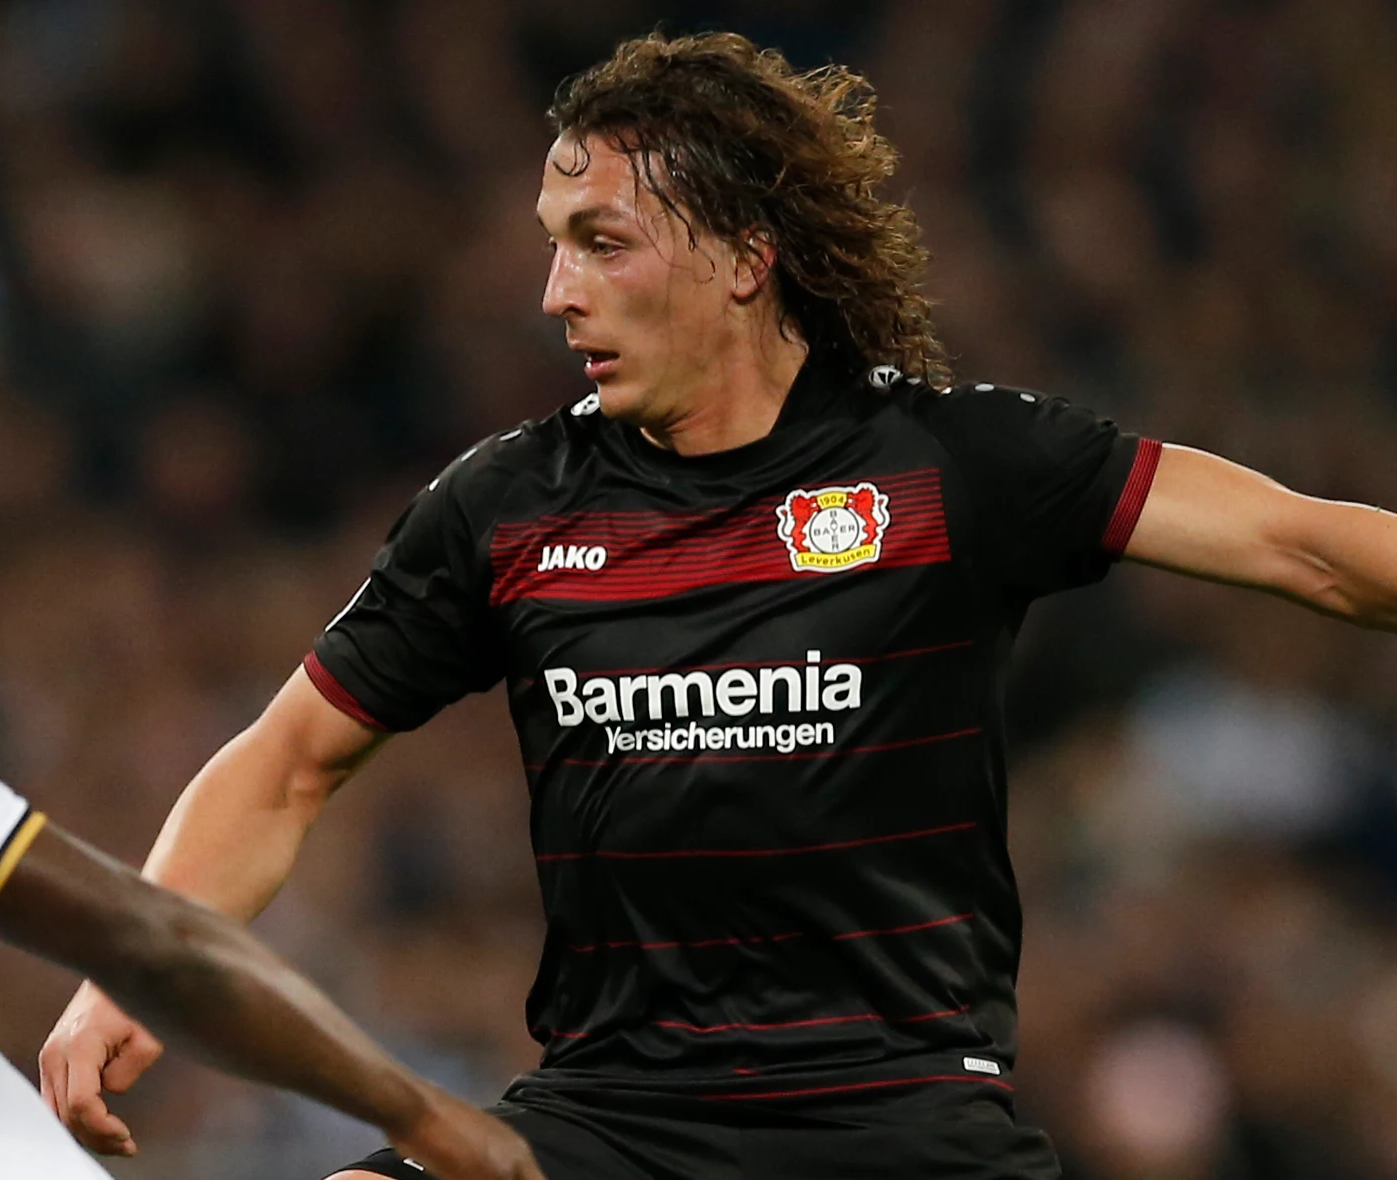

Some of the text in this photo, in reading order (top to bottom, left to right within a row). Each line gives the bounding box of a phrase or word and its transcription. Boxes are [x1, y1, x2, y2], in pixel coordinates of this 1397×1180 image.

[537, 544, 607, 573] JAKO
[800, 548, 870, 565] Leverkusen
[544, 650, 863, 727] Barmenia
[605, 721, 835, 753] Versicherungen
